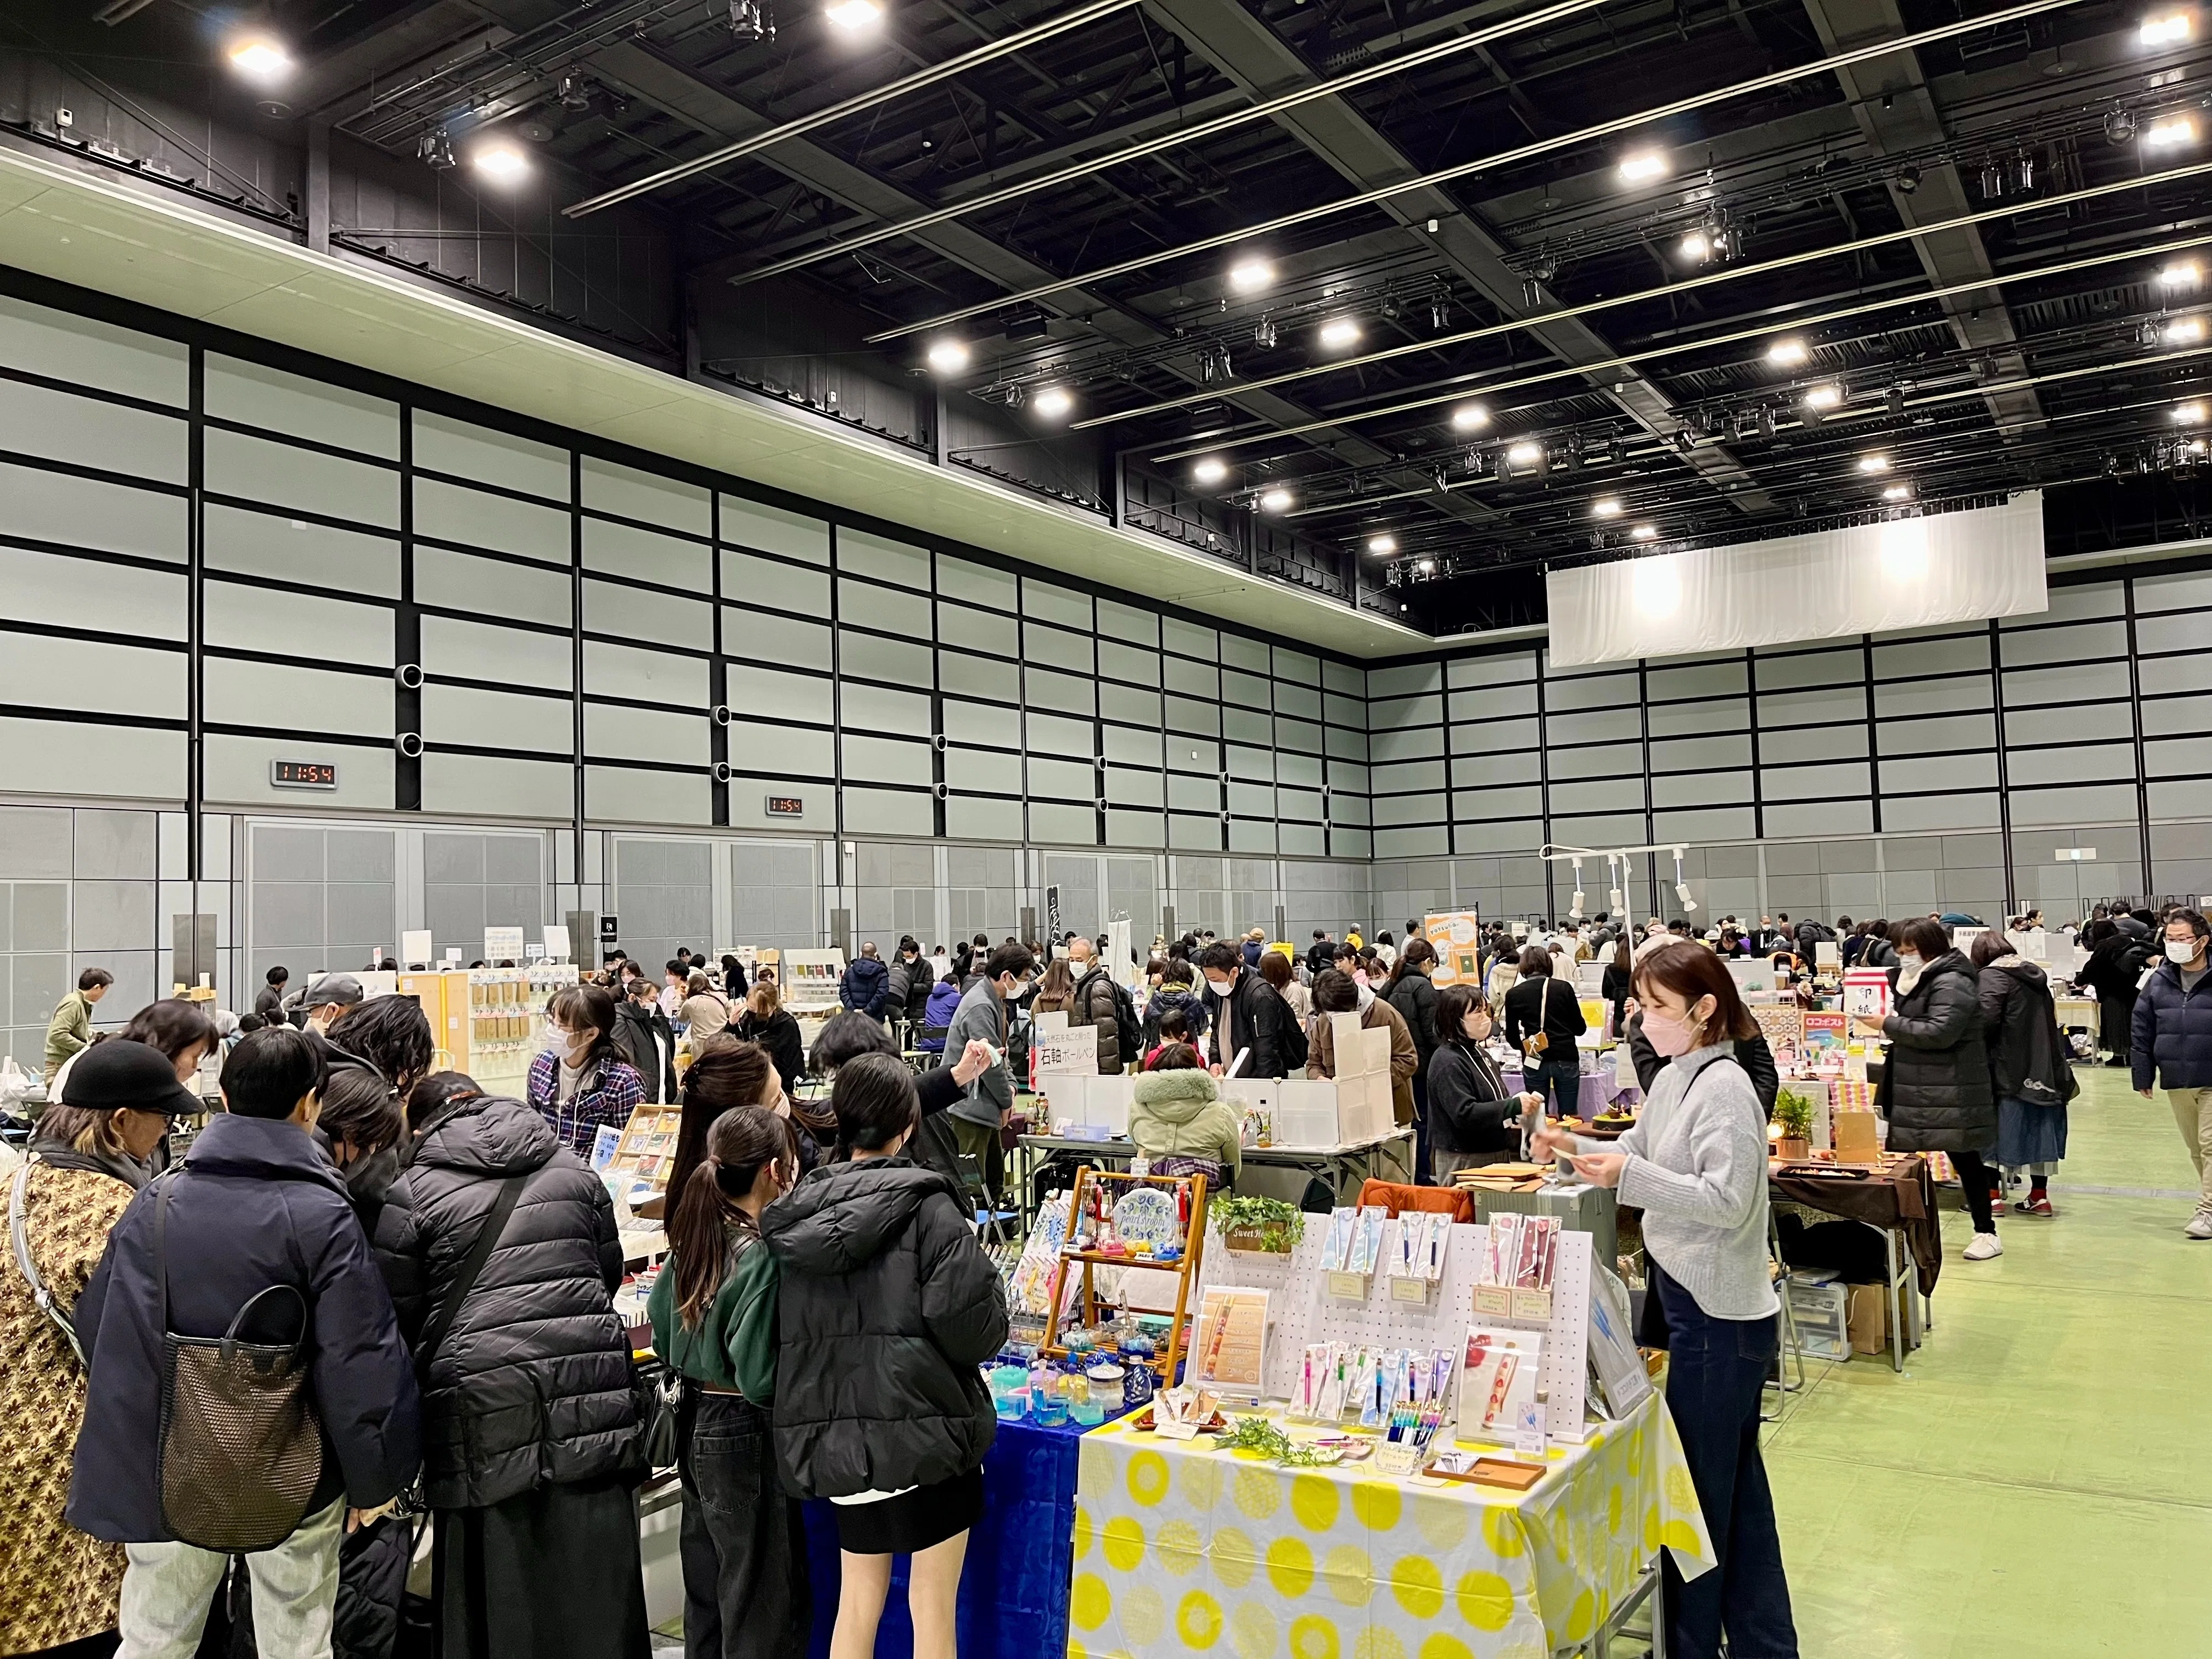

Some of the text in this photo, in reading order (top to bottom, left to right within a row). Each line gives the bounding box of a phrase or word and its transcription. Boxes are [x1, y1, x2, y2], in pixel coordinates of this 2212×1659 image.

[284, 765, 331, 782] 11:54
[773, 799, 800, 811] 11:54
[1806, 1017, 1844, 1027] ロコポスト
[1046, 1032, 1091, 1044] 天然石を丸ごと削った
[1041, 1047, 1095, 1066] 石軸ボールペン
[1120, 1214, 1165, 1226] pearl's room
[1233, 1228, 1253, 1237] Sweet
